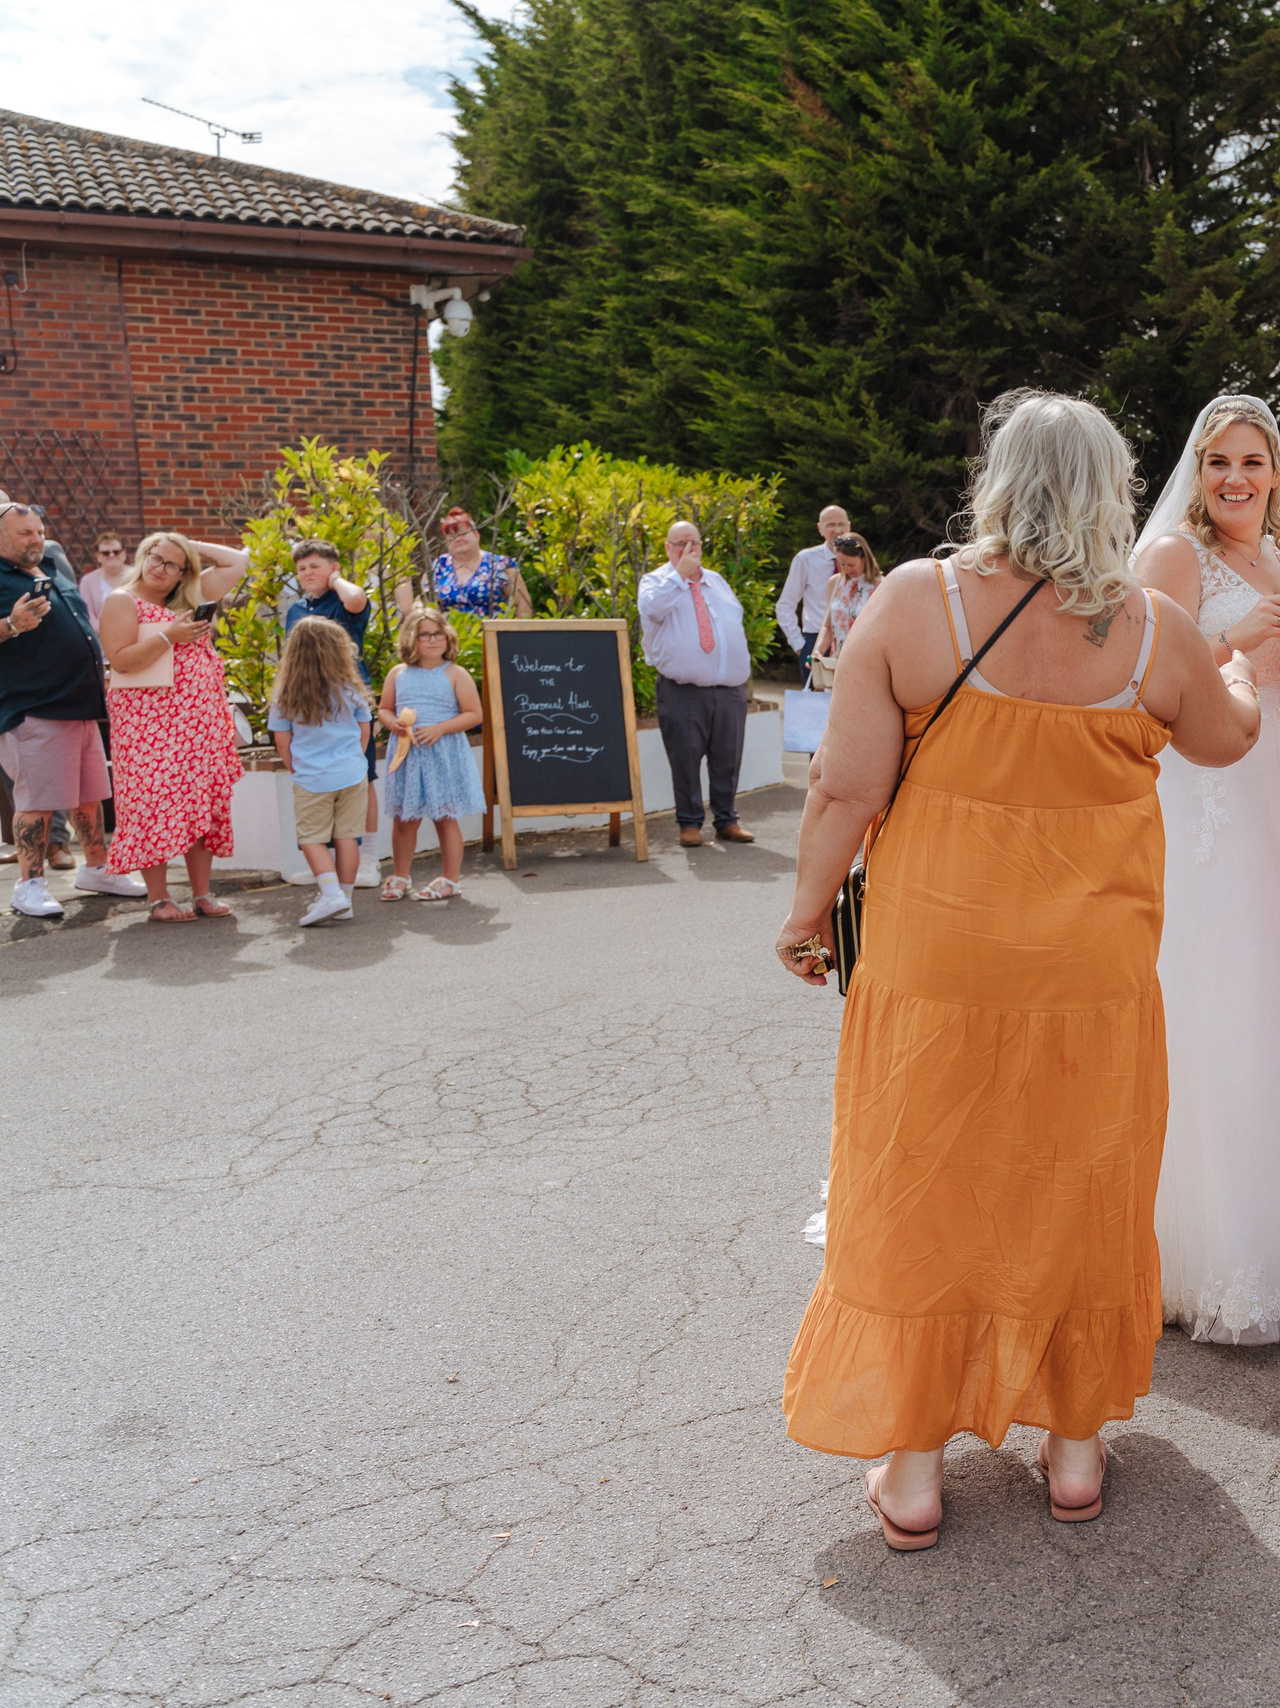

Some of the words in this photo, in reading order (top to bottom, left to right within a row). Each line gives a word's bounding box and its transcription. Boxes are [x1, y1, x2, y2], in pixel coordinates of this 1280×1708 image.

[511, 654, 562, 672] Welcome
[565, 657, 586, 671] to
[539, 678, 555, 686] THE
[514, 694, 564, 713] Baronial
